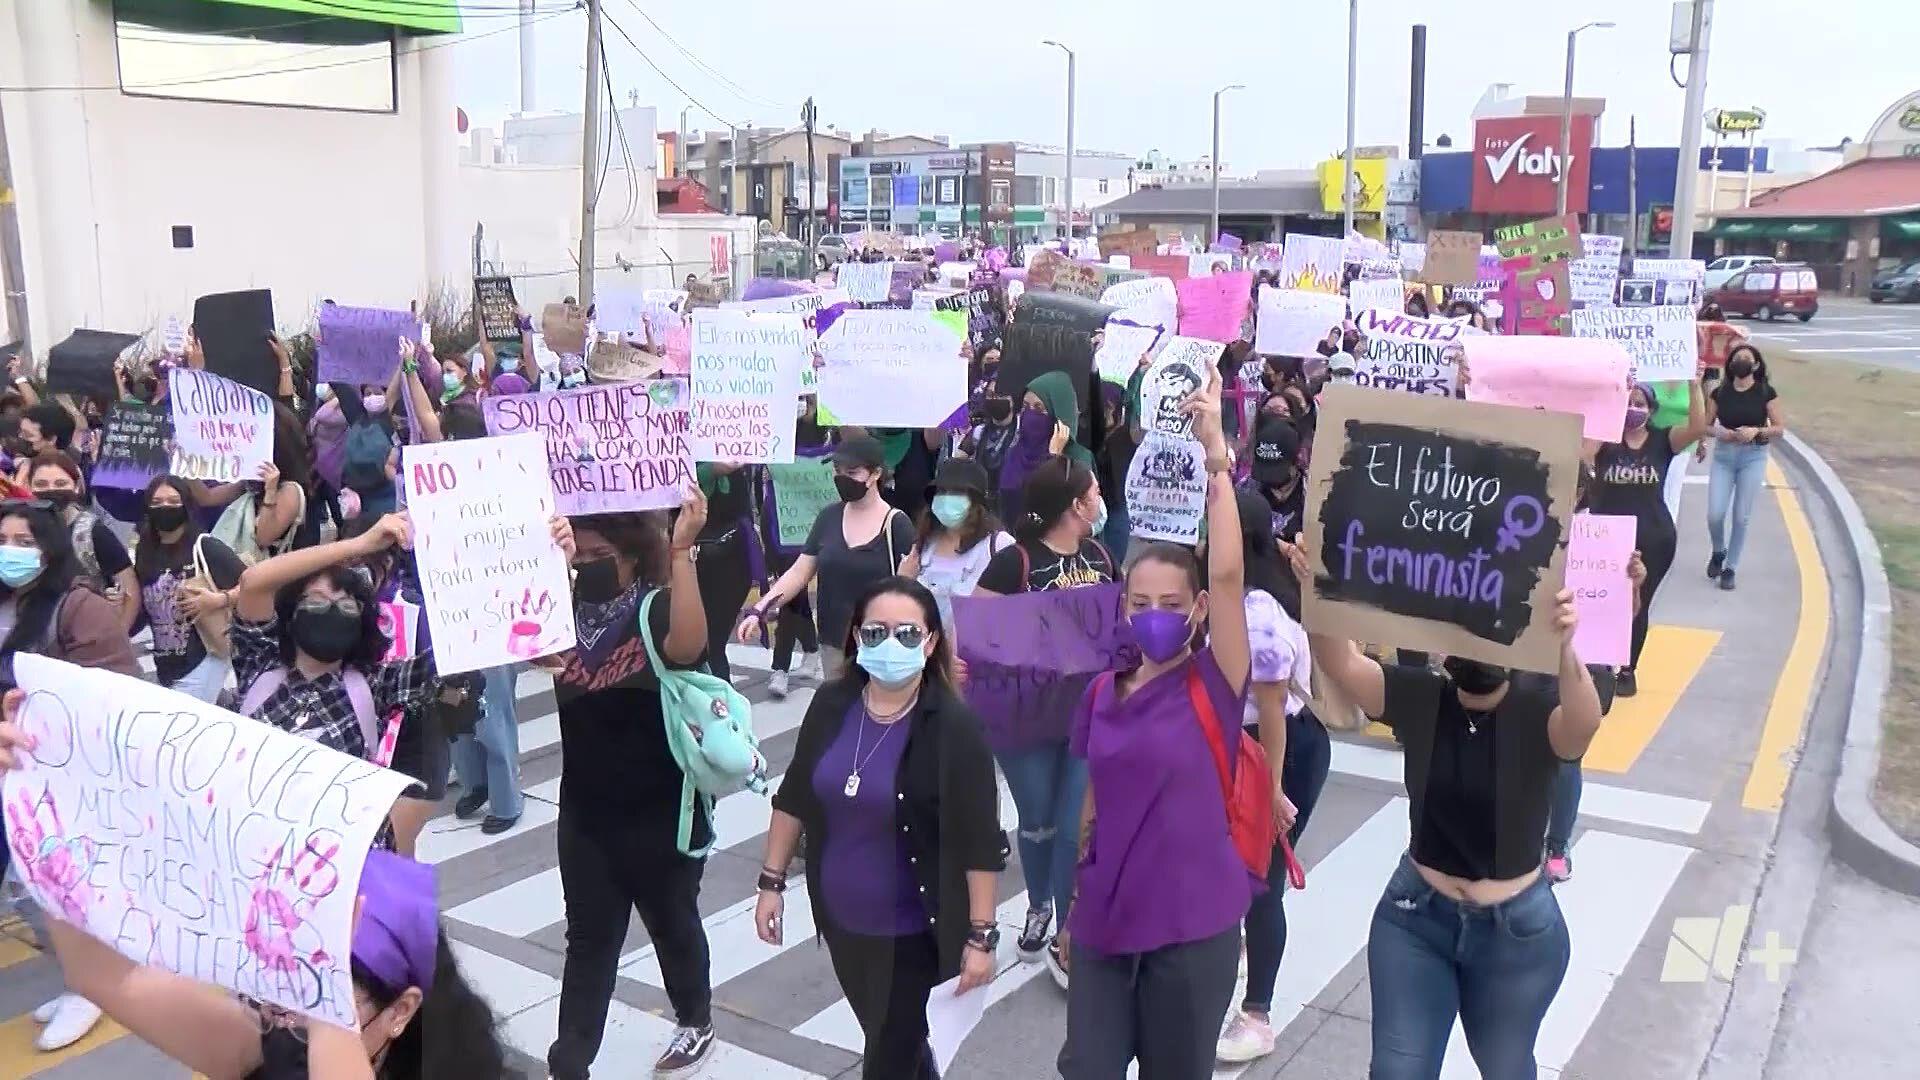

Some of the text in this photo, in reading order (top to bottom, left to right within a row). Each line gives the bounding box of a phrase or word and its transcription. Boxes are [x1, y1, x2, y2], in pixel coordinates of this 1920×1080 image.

[1484, 131, 1575, 184] Vialy
[1605, 325, 1655, 340] MUJER
[696, 353, 724, 372] nos
[1388, 363, 1424, 378] OTHER
[695, 376, 774, 395] nos violan
[497, 383, 651, 431] SOLO TIENES
[589, 419, 634, 440] VIDA
[696, 420, 771, 438] somos las
[594, 439, 643, 462] COMO
[646, 434, 692, 457] UNA
[714, 435, 781, 459] nazis?
[413, 461, 458, 496] NO
[601, 457, 696, 492] LEYENDA
[1365, 442, 1501, 506] El futuro
[1604, 465, 1659, 483] ALOHA
[463, 523, 526, 550] mujer
[1337, 519, 1505, 611] feminista
[1567, 552, 1619, 571] brinas
[1576, 587, 1608, 599] edo
[440, 607, 471, 626] por
[20, 689, 383, 827] QUIERO VER
[75, 785, 144, 838] MIS
[162, 801, 345, 898] AMIGAS
